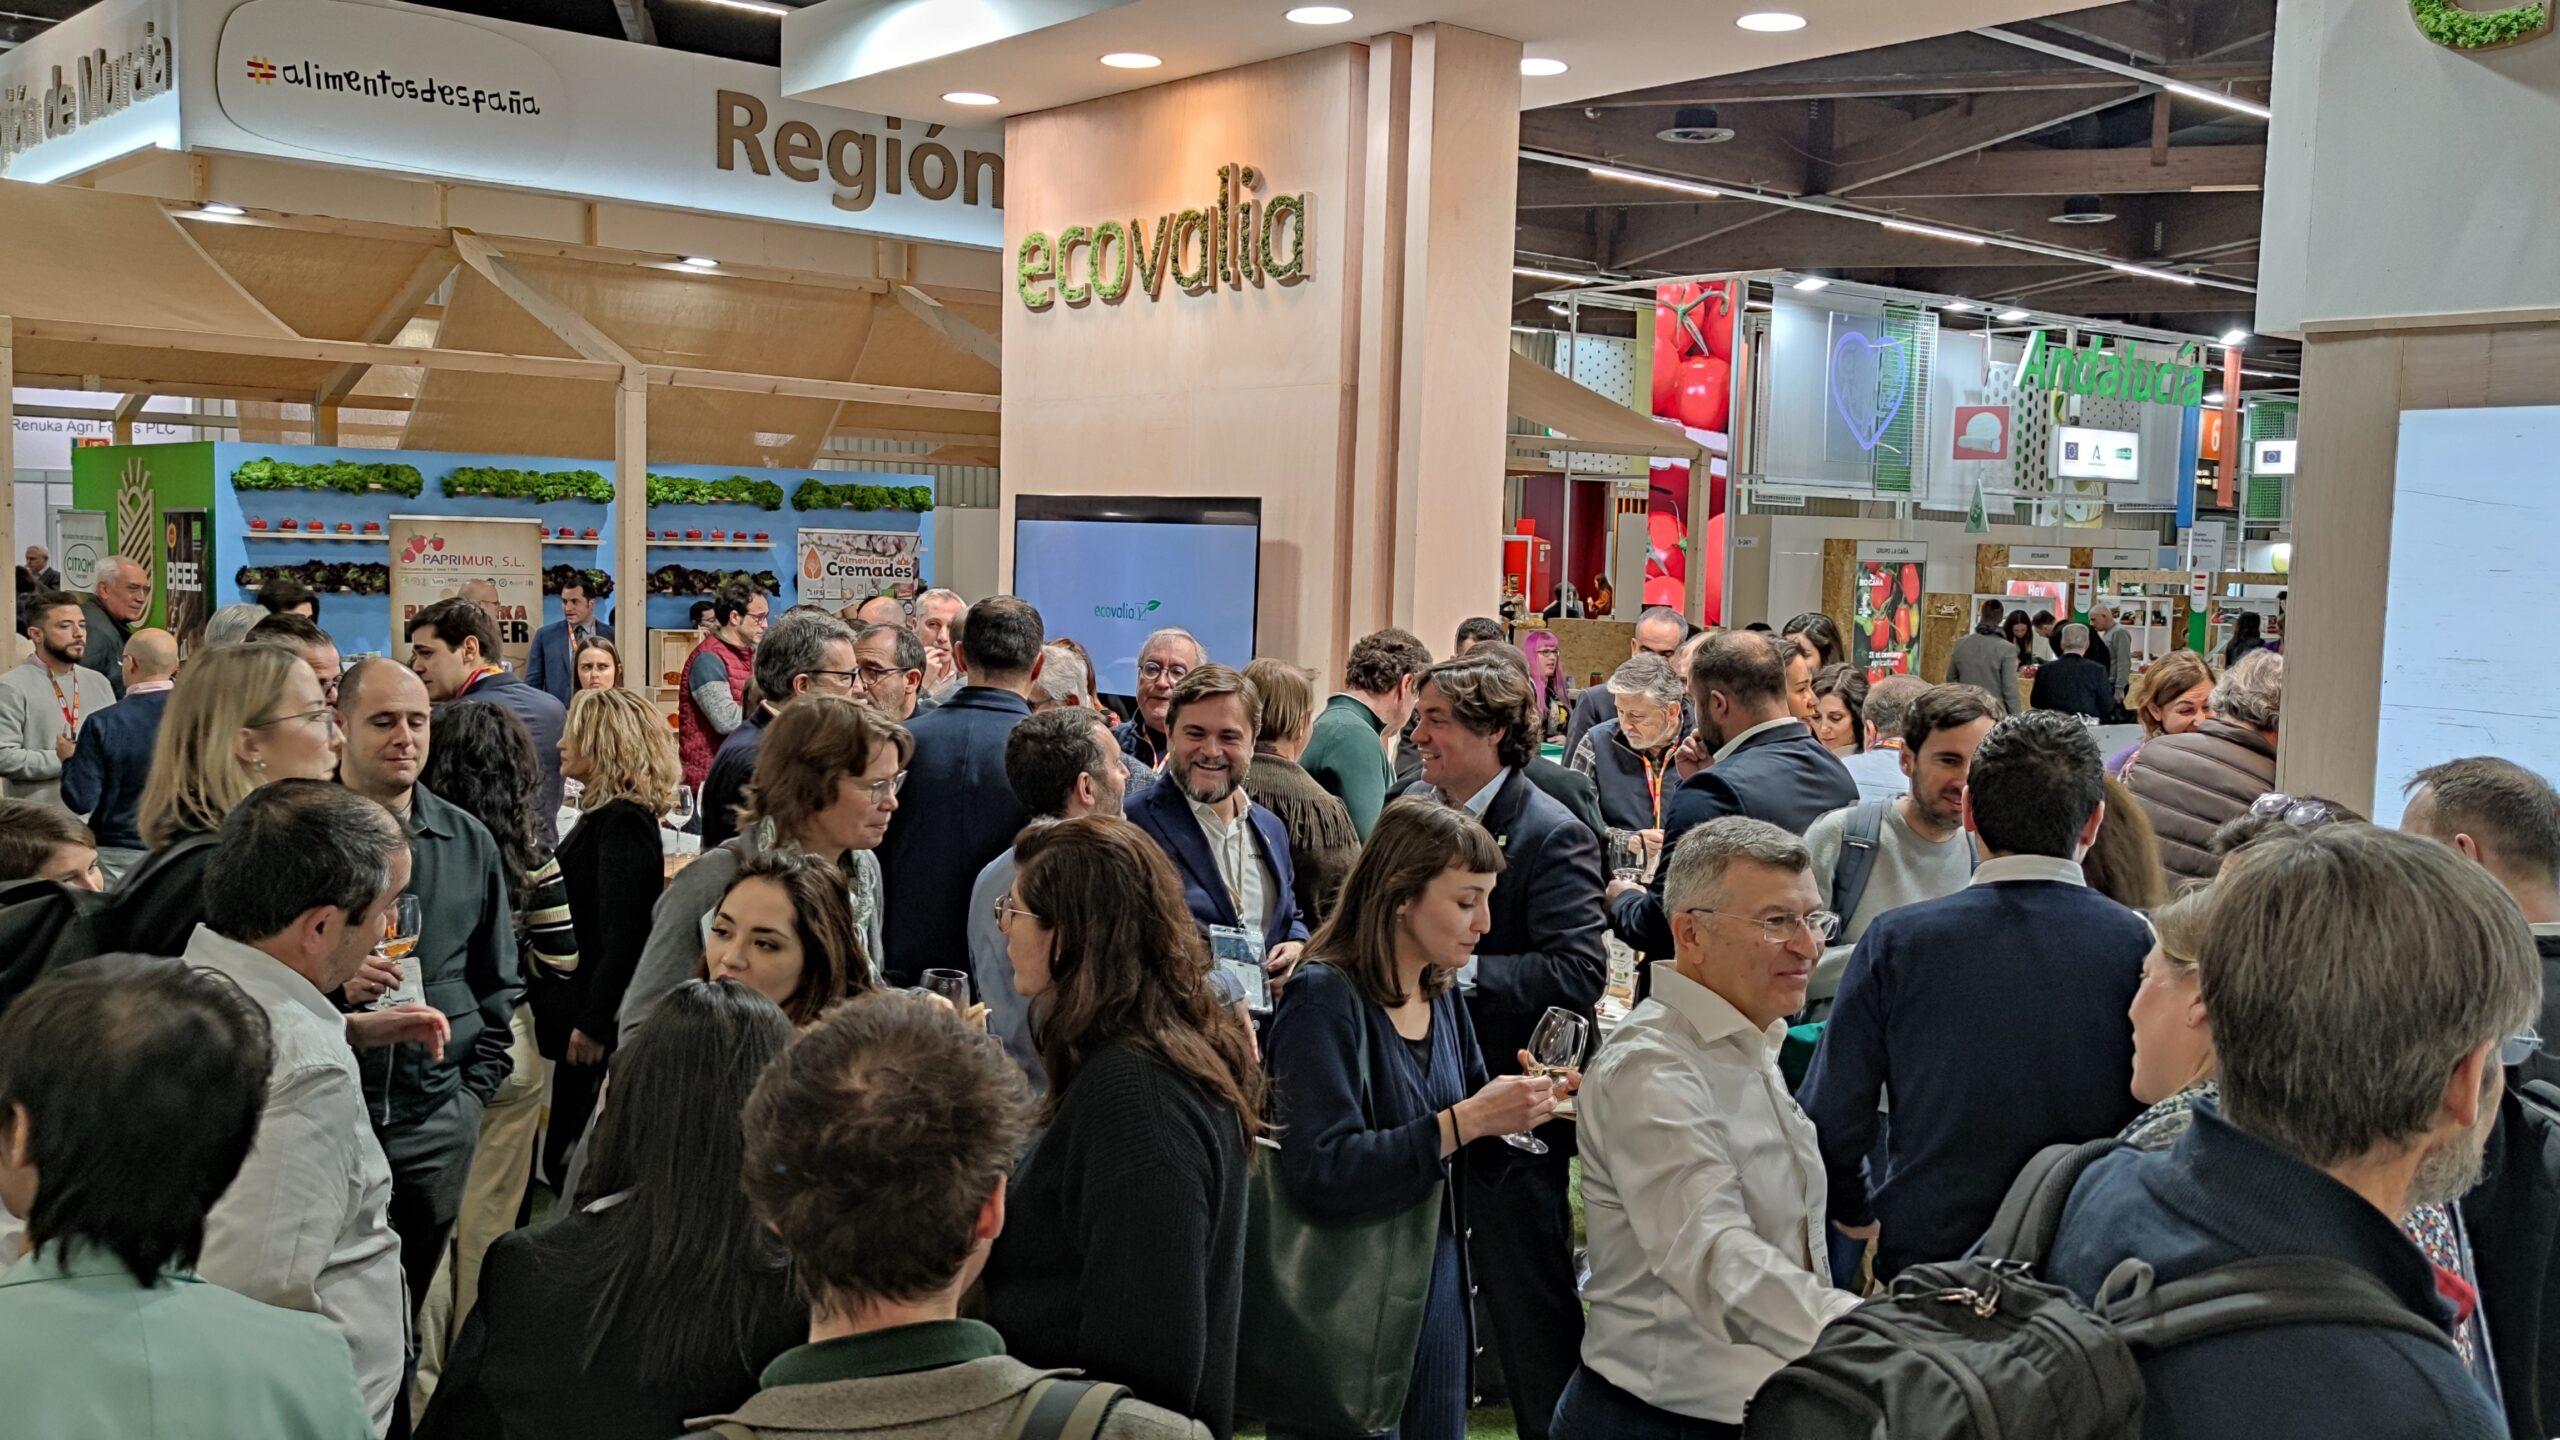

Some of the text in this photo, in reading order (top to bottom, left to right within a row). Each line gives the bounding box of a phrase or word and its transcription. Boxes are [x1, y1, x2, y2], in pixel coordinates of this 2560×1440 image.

[44, 65, 76, 139] de
[78, 21, 173, 125] Murcia
[247, 55, 540, 115] #alimentosdespaña
[716, 89, 1005, 212] Región
[1017, 163, 1314, 308] ecovalia
[2013, 330, 2204, 406] Andalucía
[13, 418, 176, 435] Renuka Agri Fos PLC
[422, 554, 526, 568] PAPRIMUR, S.L.
[838, 555, 890, 565] Almendras
[826, 562, 912, 578] Cremades
[2027, 583, 2046, 597] Hey
[1094, 602, 1135, 619] ecovalia
